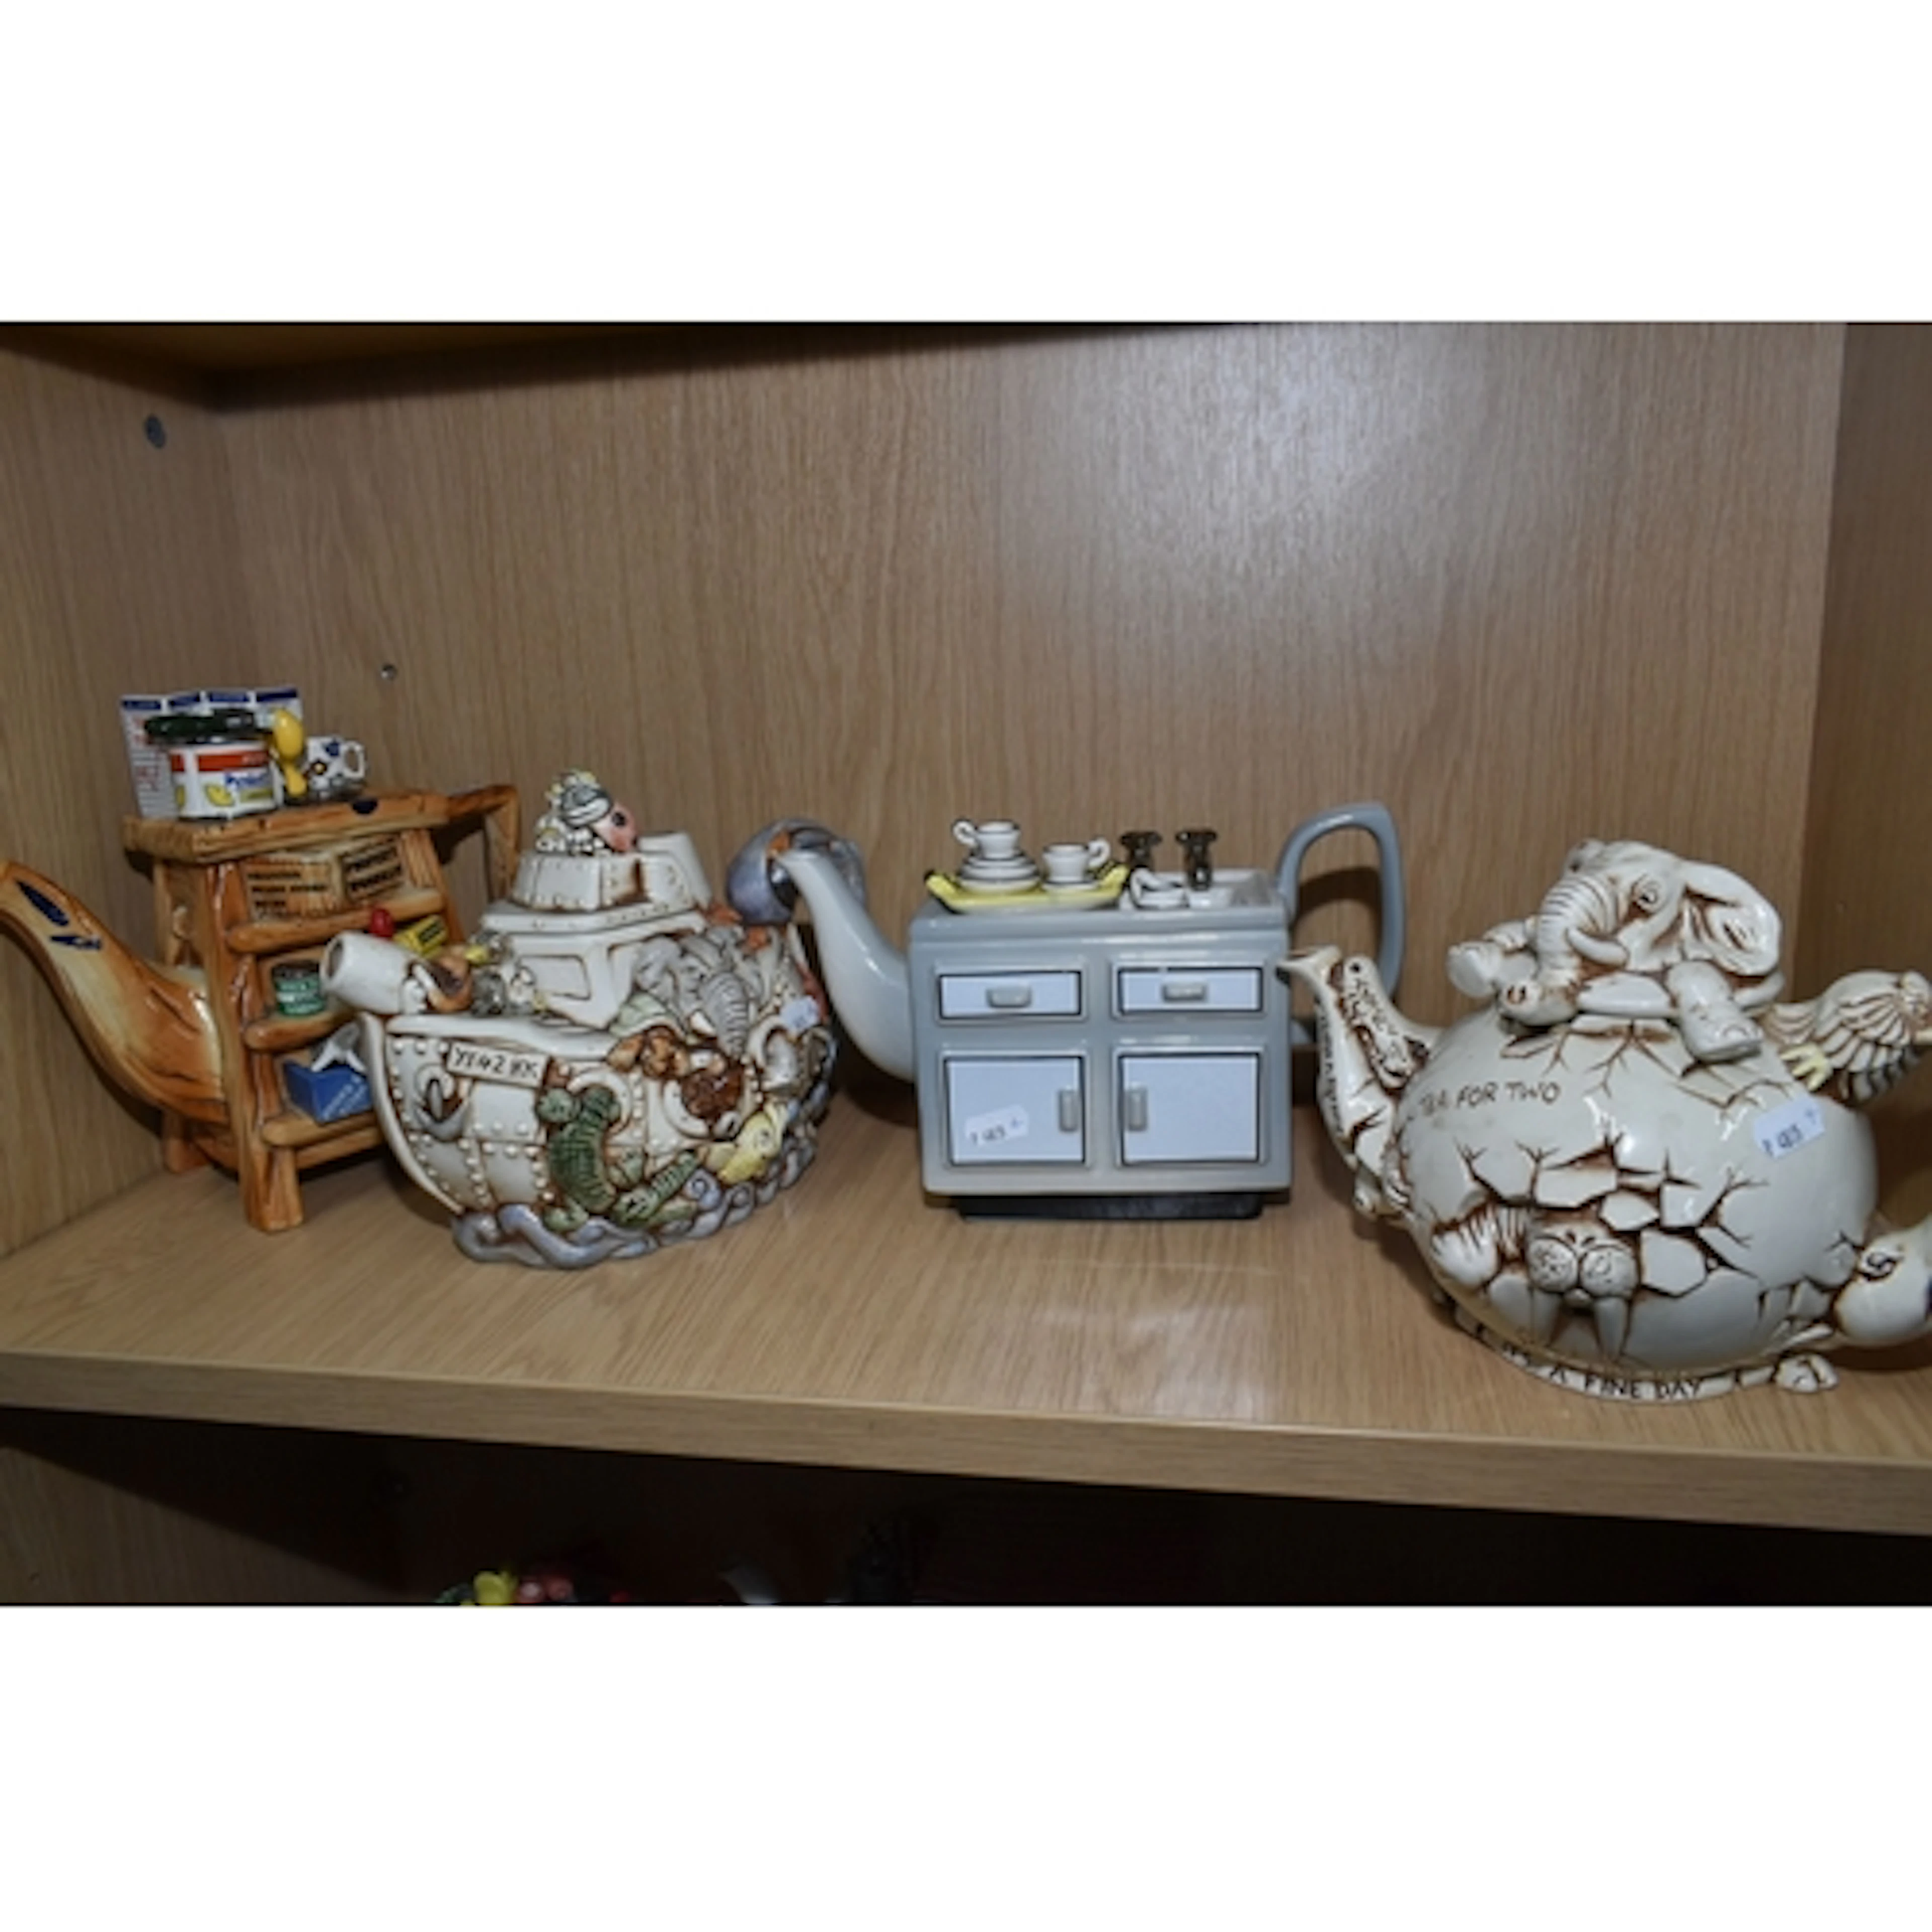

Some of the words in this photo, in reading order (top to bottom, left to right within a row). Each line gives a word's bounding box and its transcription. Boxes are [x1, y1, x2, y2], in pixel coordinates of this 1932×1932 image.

[1457, 1081, 1498, 1108] FOR
[1505, 1081, 1560, 1105] TWO
[1585, 1371, 1642, 1400] FINE
[1656, 1378, 1702, 1400] DAY
